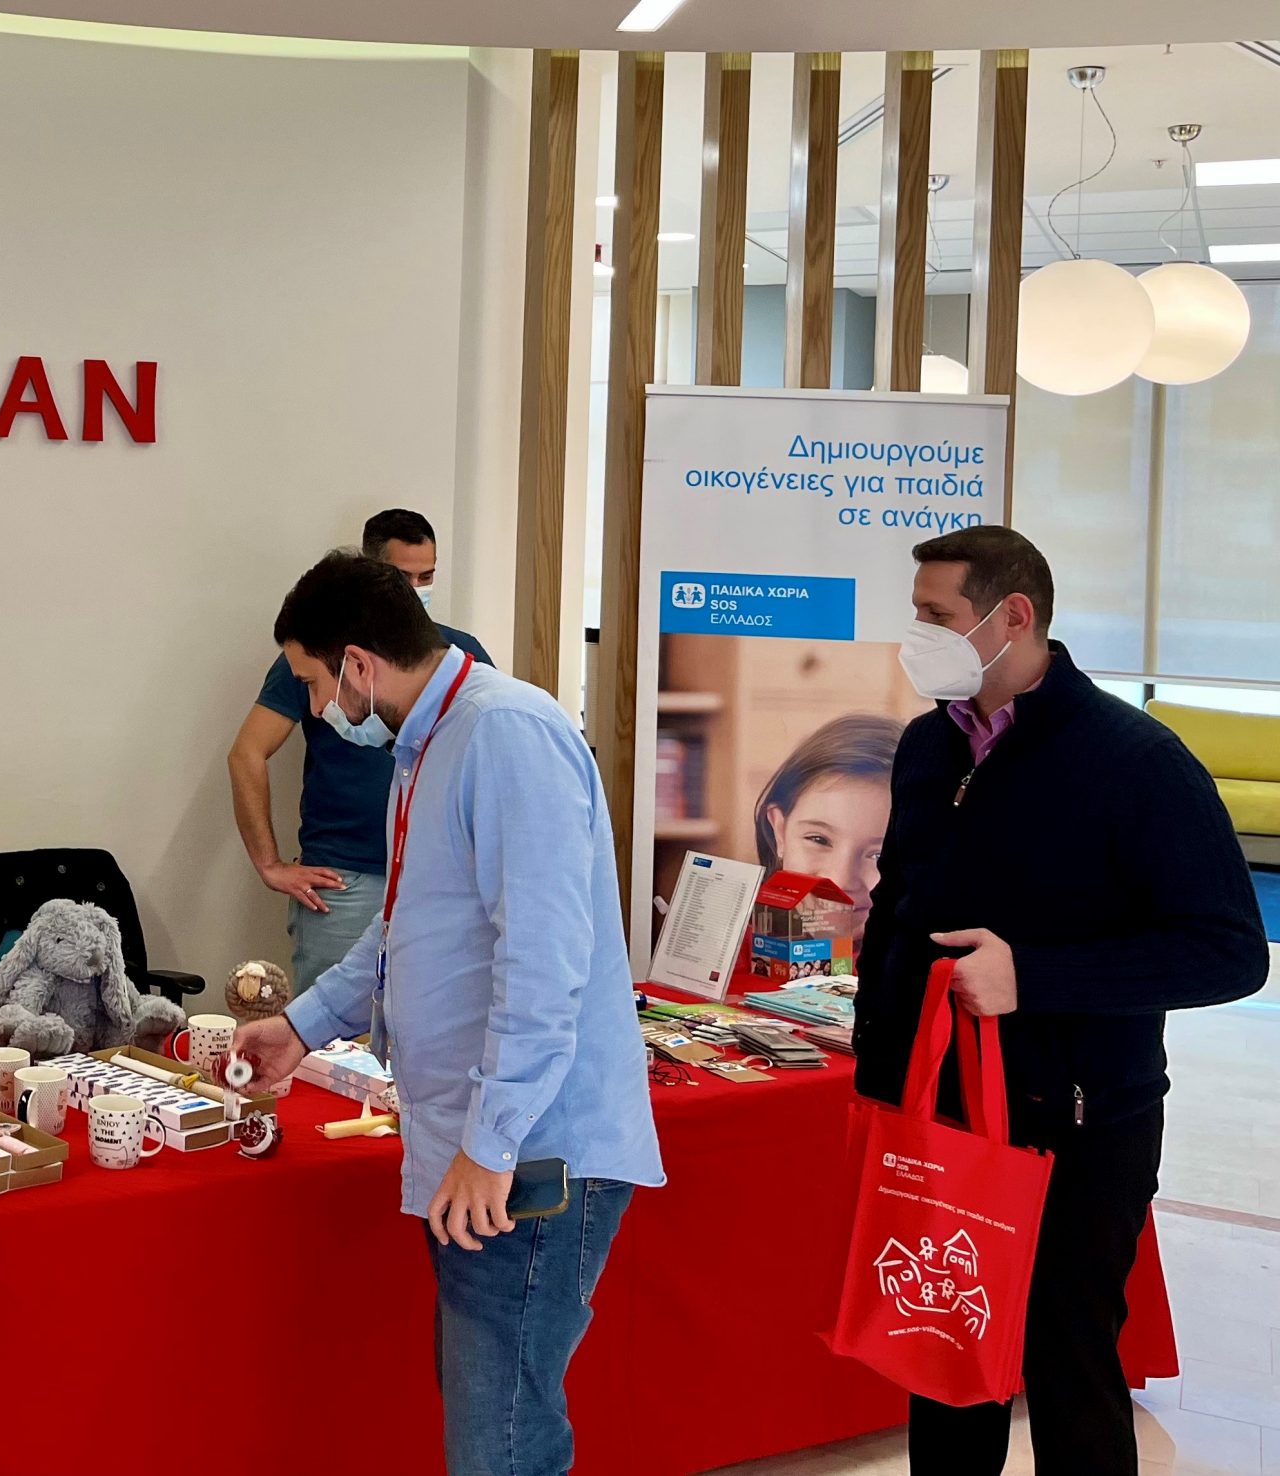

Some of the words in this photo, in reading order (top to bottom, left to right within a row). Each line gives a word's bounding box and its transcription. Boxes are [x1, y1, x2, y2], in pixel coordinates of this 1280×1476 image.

[787, 434, 985, 466] Δημιουργούμε
[685, 467, 834, 497] οικογένειες
[844, 474, 884, 498] για
[894, 473, 984, 497] παιδιά
[838, 507, 871, 526] σε
[710, 584, 765, 597] ΠΑΙΔΙΚΑ
[767, 587, 809, 599] ΧΩΡΙΑ
[710, 600, 738, 611] SOS
[710, 613, 773, 627] ΕΛΛΑΔΟΣ
[96, 1119, 121, 1128] ENJOY
[100, 1128, 115, 1137] THE
[94, 1135, 123, 1145] MOMENT
